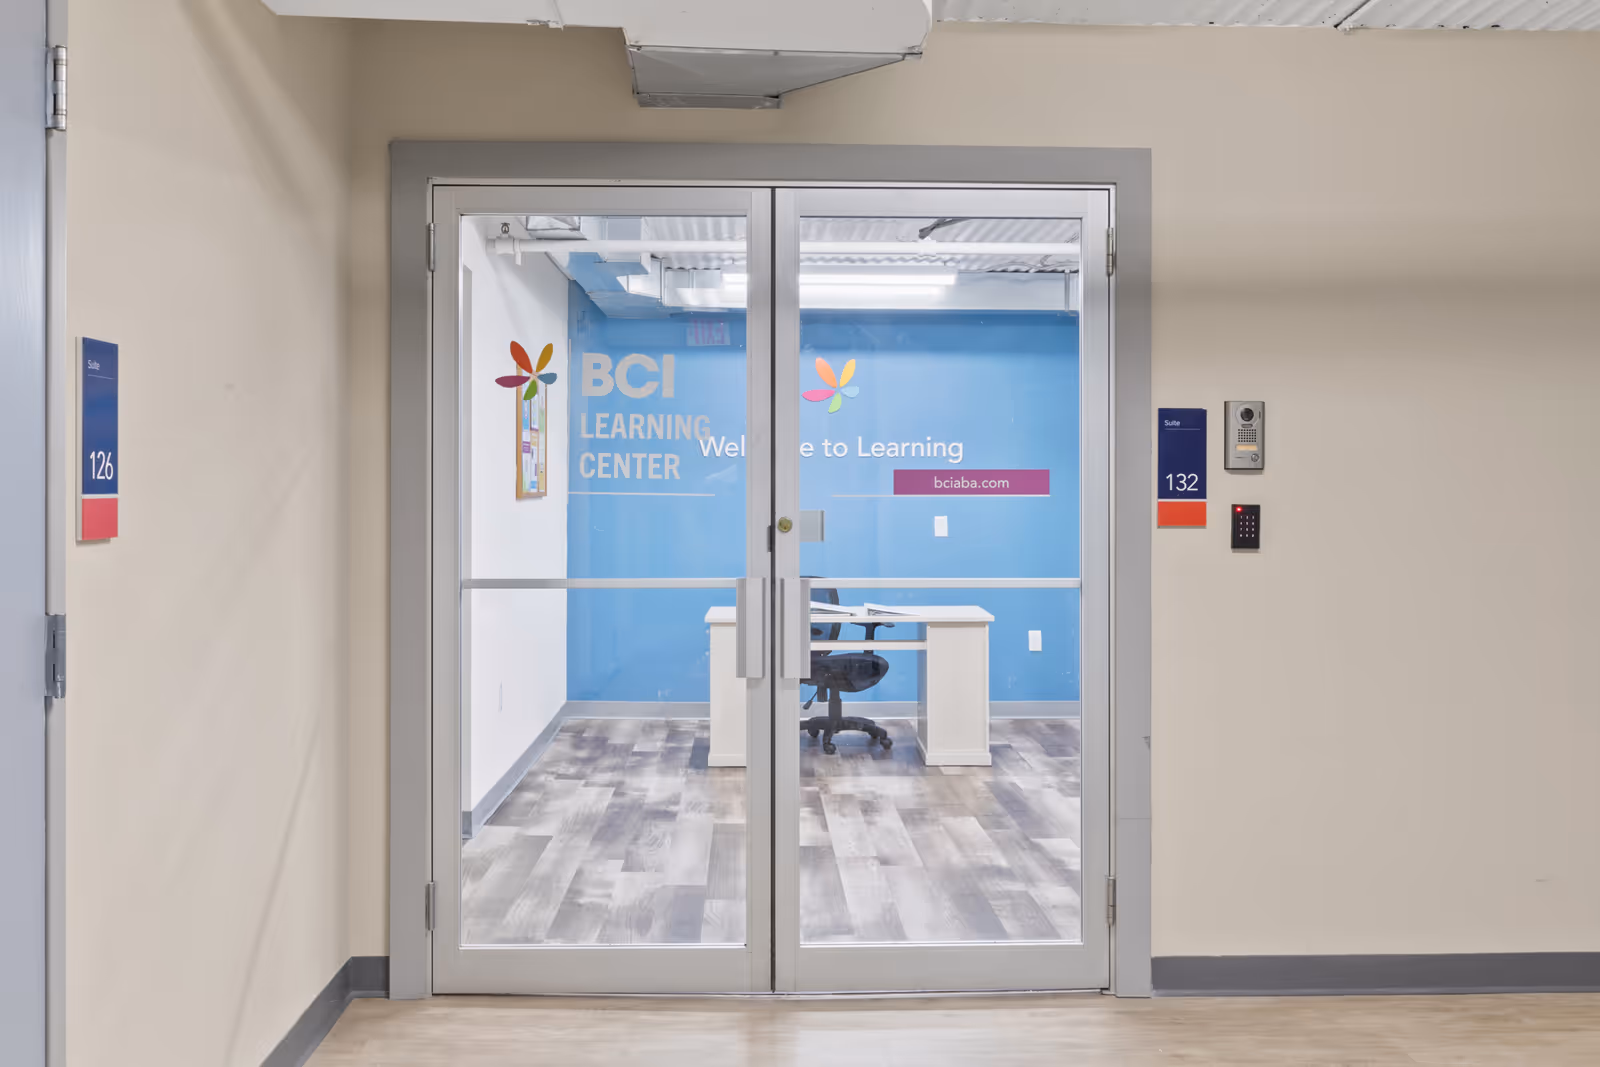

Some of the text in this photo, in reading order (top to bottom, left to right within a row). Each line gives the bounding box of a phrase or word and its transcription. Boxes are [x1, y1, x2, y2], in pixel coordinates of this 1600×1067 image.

[88, 359, 100, 370] Suite
[582, 352, 675, 398] BCI
[580, 413, 711, 440] LEARNING
[1164, 419, 1181, 427] Suite
[699, 435, 964, 463] Wele to Learning
[89, 450, 114, 480] 126
[579, 452, 681, 479] CENTER
[934, 476, 1010, 490] bciaba.com
[1165, 473, 1199, 491] 132
